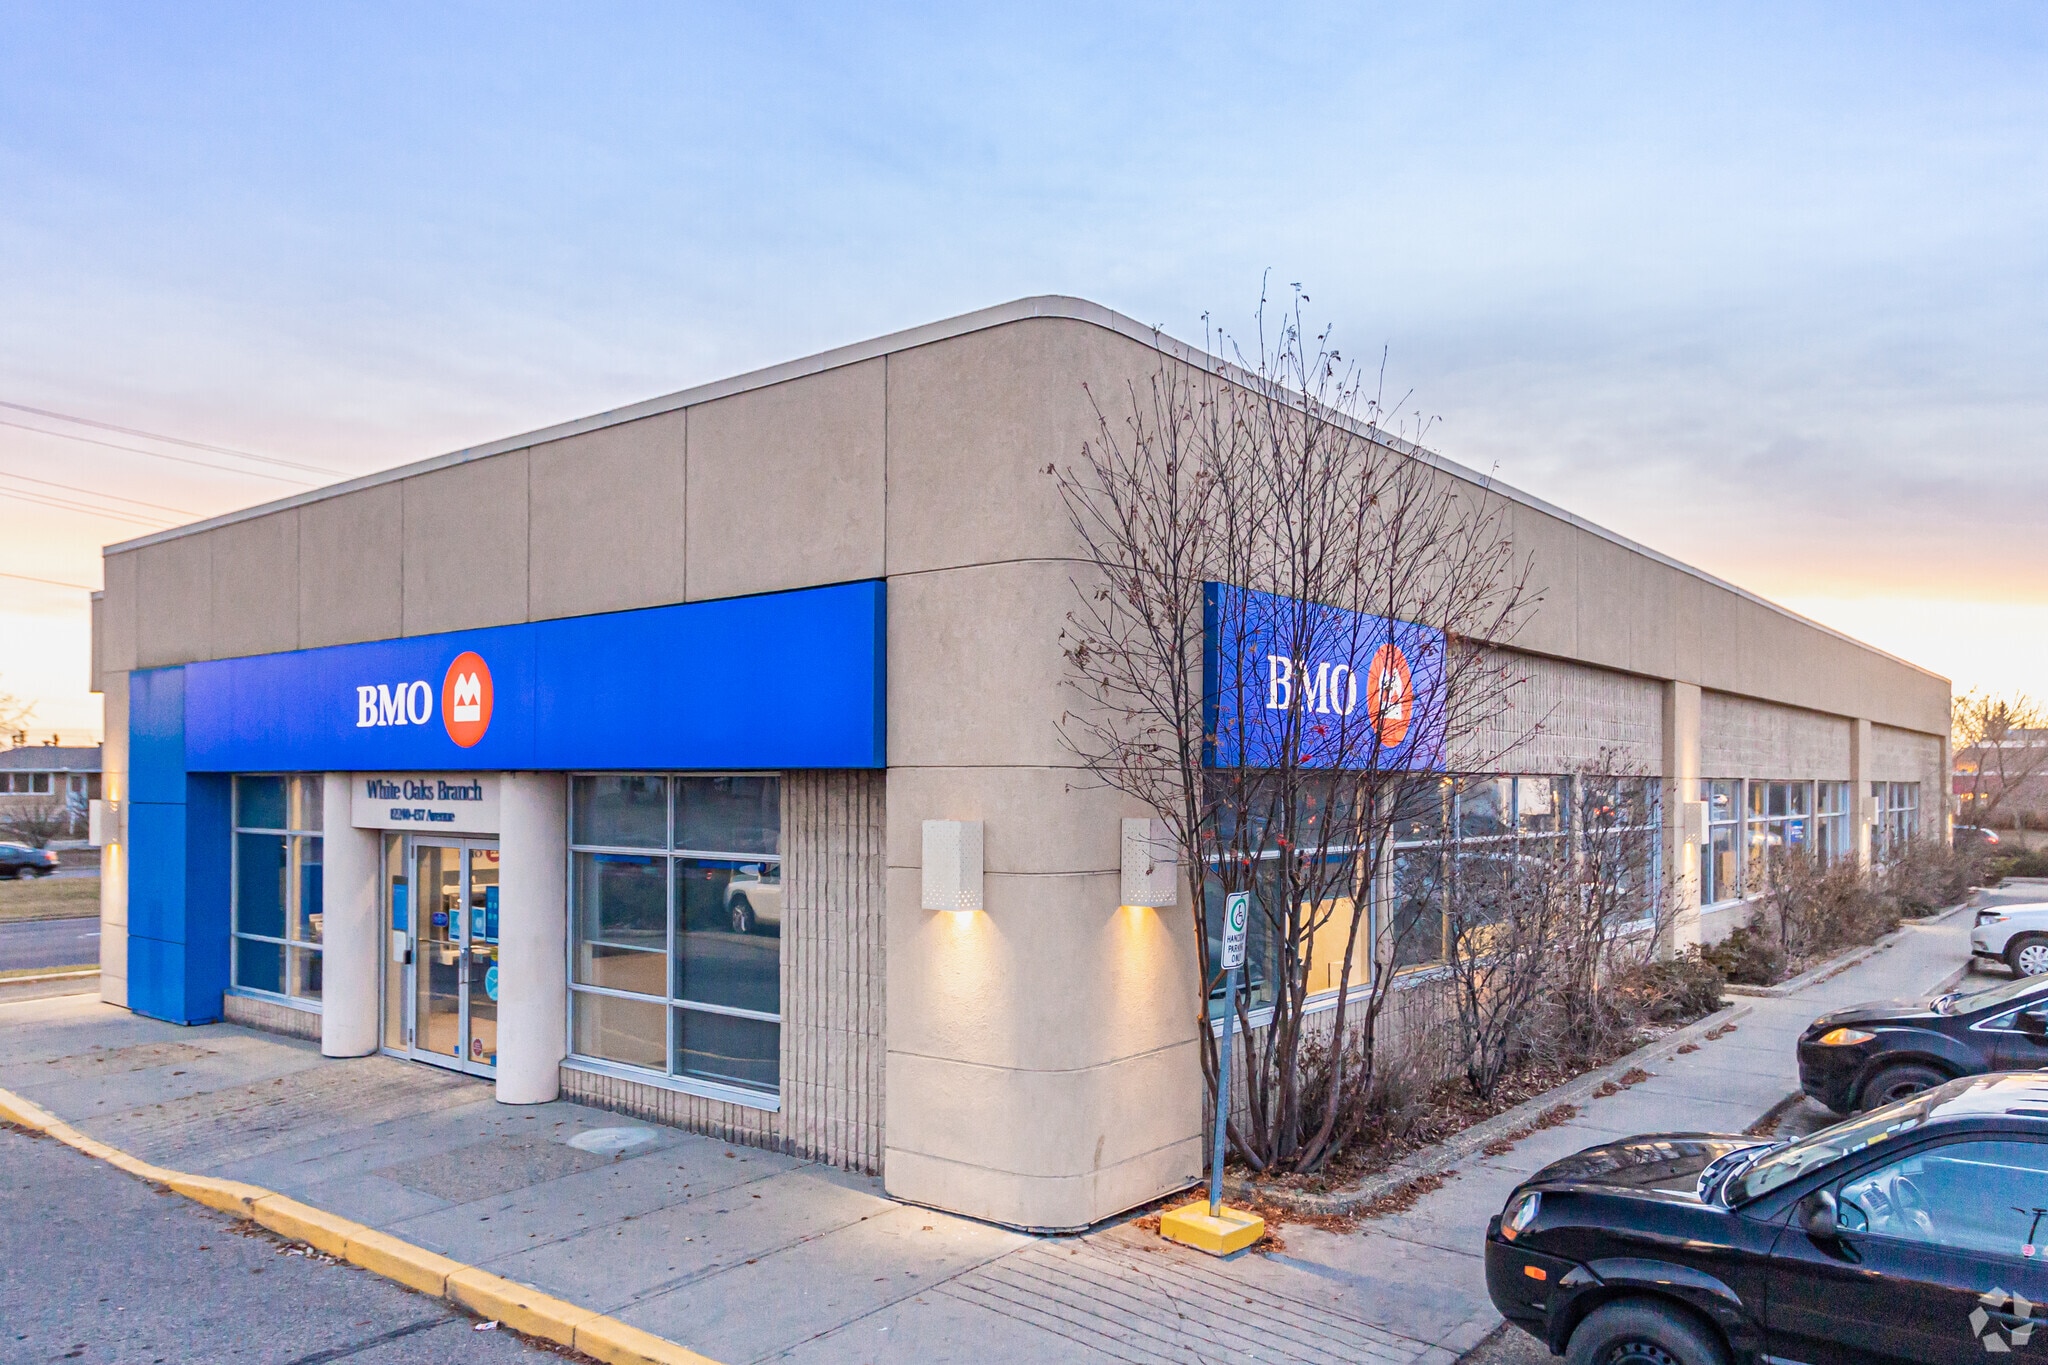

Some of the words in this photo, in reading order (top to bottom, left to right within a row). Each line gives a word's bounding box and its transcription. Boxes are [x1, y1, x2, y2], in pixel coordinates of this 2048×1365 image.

[356, 680, 433, 727] BMO
[1266, 655, 1357, 717] BMO
[366, 779, 400, 800] White
[403, 779, 434, 801] Oaks
[437, 778, 482, 801] Branch
[426, 809, 455, 822] Avenue
